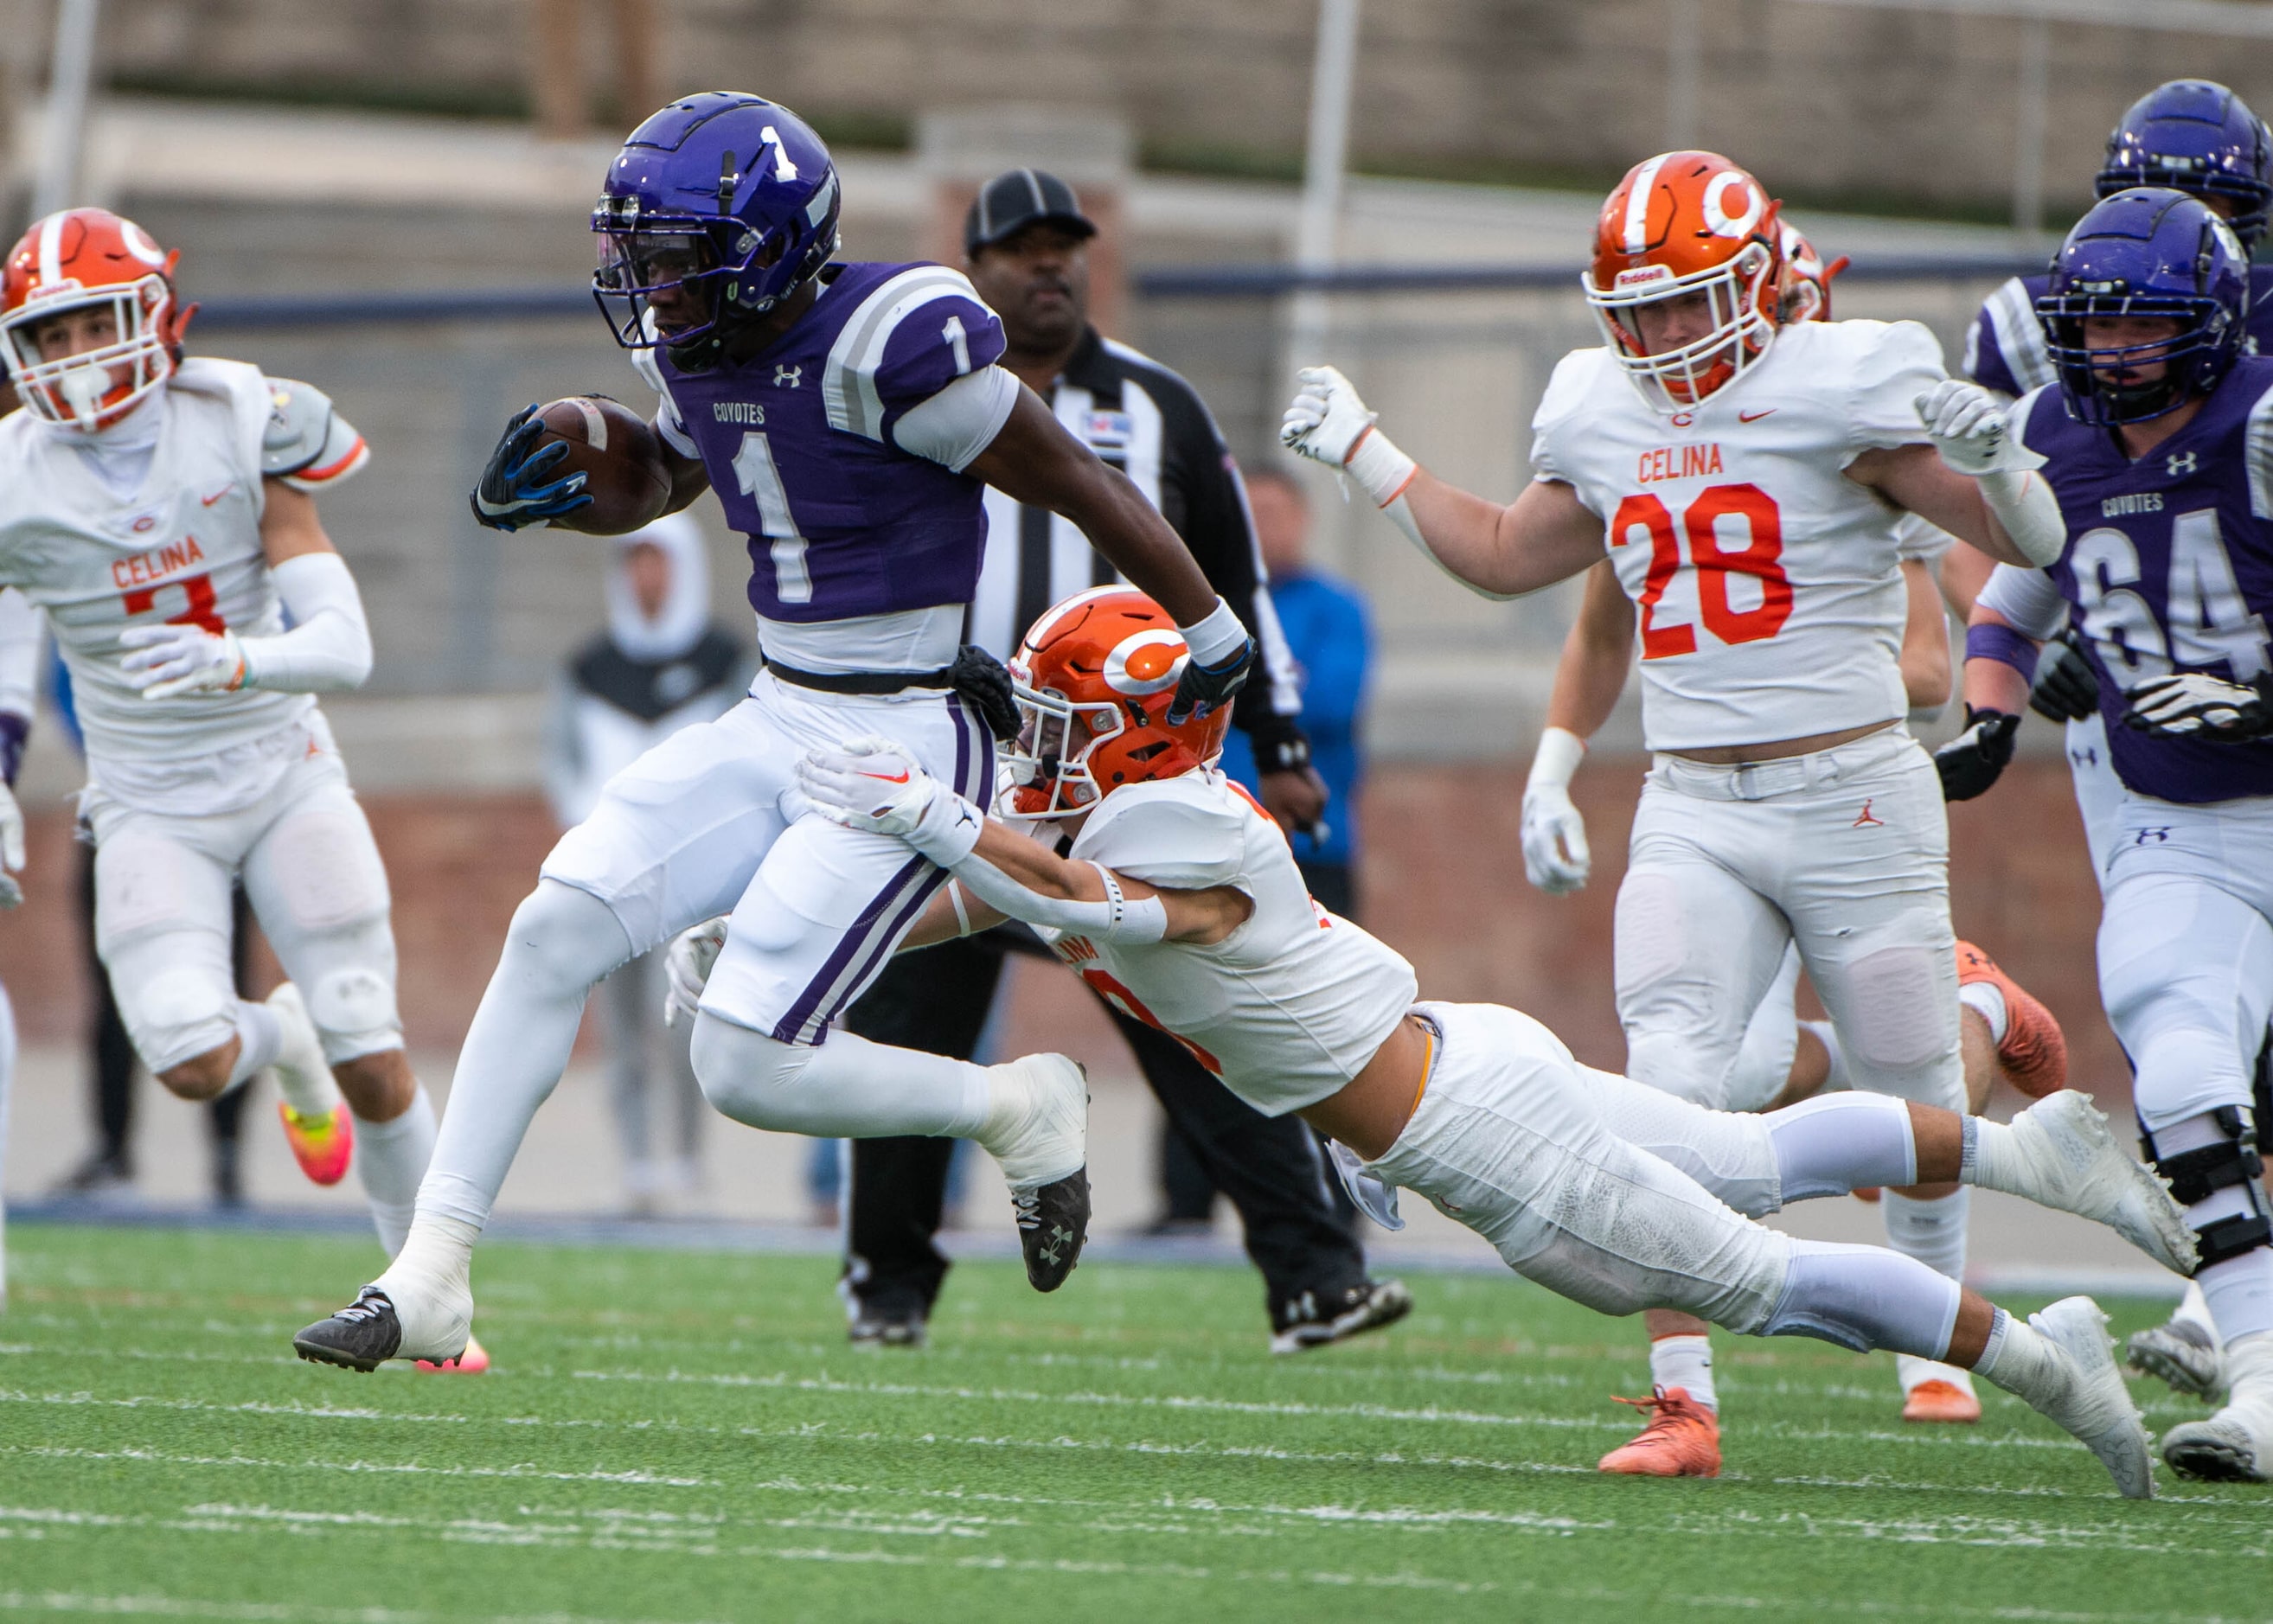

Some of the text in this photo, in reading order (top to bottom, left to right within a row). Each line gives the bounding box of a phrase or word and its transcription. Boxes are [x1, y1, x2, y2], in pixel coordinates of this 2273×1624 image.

[760, 126, 798, 182] 1
[941, 316, 971, 374] 1
[714, 402, 765, 425] COYOTES
[1638, 443, 1724, 483] CELINA
[732, 431, 813, 604] 1
[2102, 493, 2164, 518] COYOTES
[111, 534, 204, 589] CELINA
[1611, 483, 1795, 660] 28
[2070, 507, 2272, 690] 64
